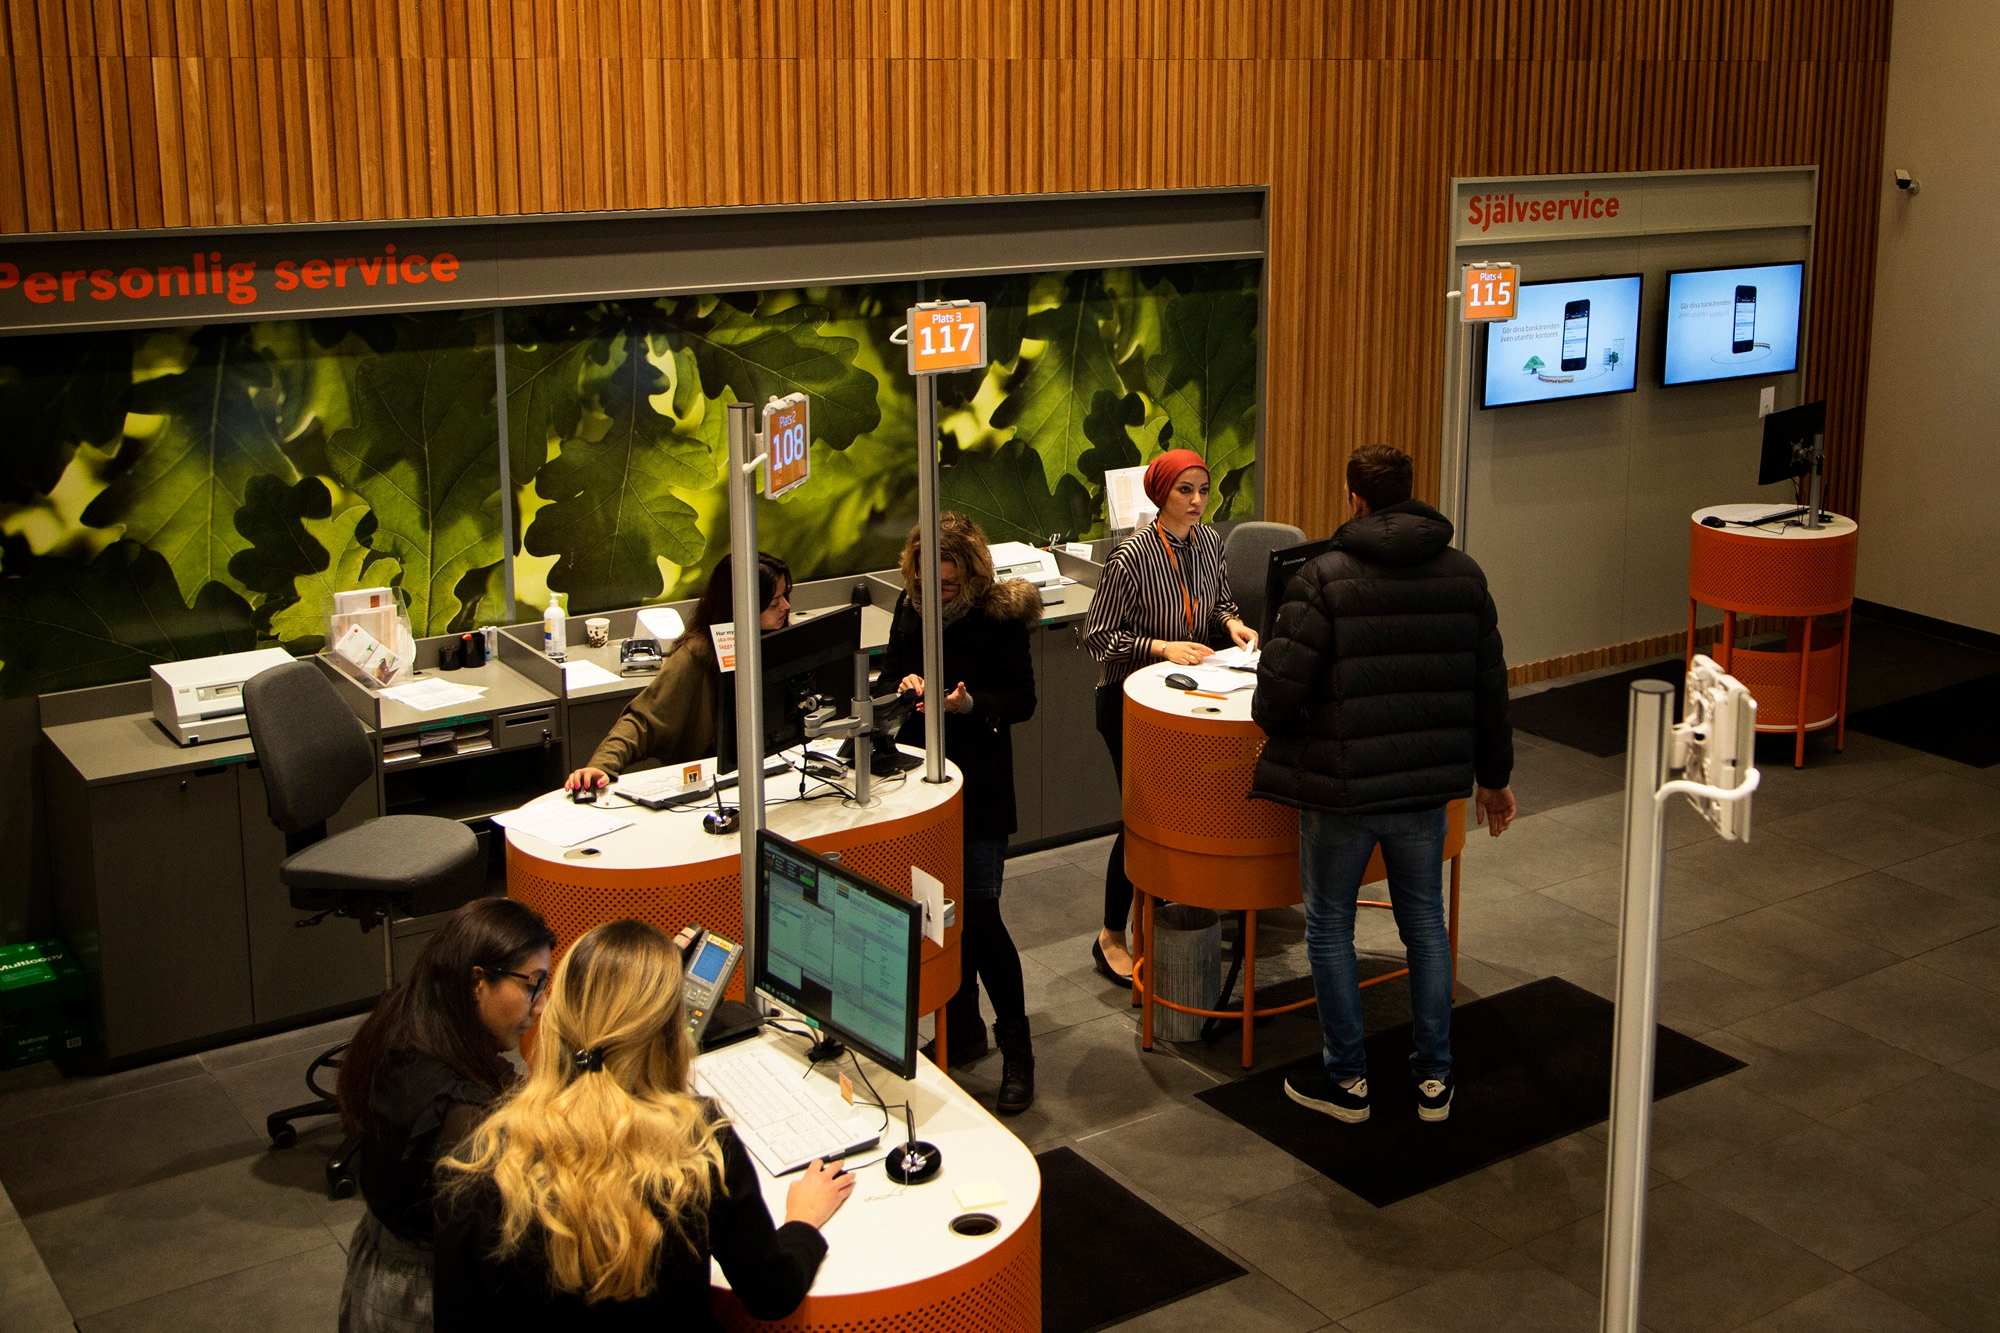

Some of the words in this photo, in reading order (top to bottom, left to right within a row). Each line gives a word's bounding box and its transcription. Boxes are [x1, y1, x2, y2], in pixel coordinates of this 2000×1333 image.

[1468, 190, 1620, 232] Självservice
[274, 243, 460, 292] service
[1480, 273, 1497, 282] Plats
[1498, 272, 1502, 281] 4
[1469, 282, 1511, 307] 115
[932, 313, 954, 324] Plats
[956, 312, 962, 322] 3
[1513, 325, 1525, 333] dina
[1525, 323, 1560, 332] bankärenden
[920, 323, 975, 355] 117
[779, 414, 792, 429] Plats
[792, 410, 797, 423] 2
[773, 423, 804, 471] 108
